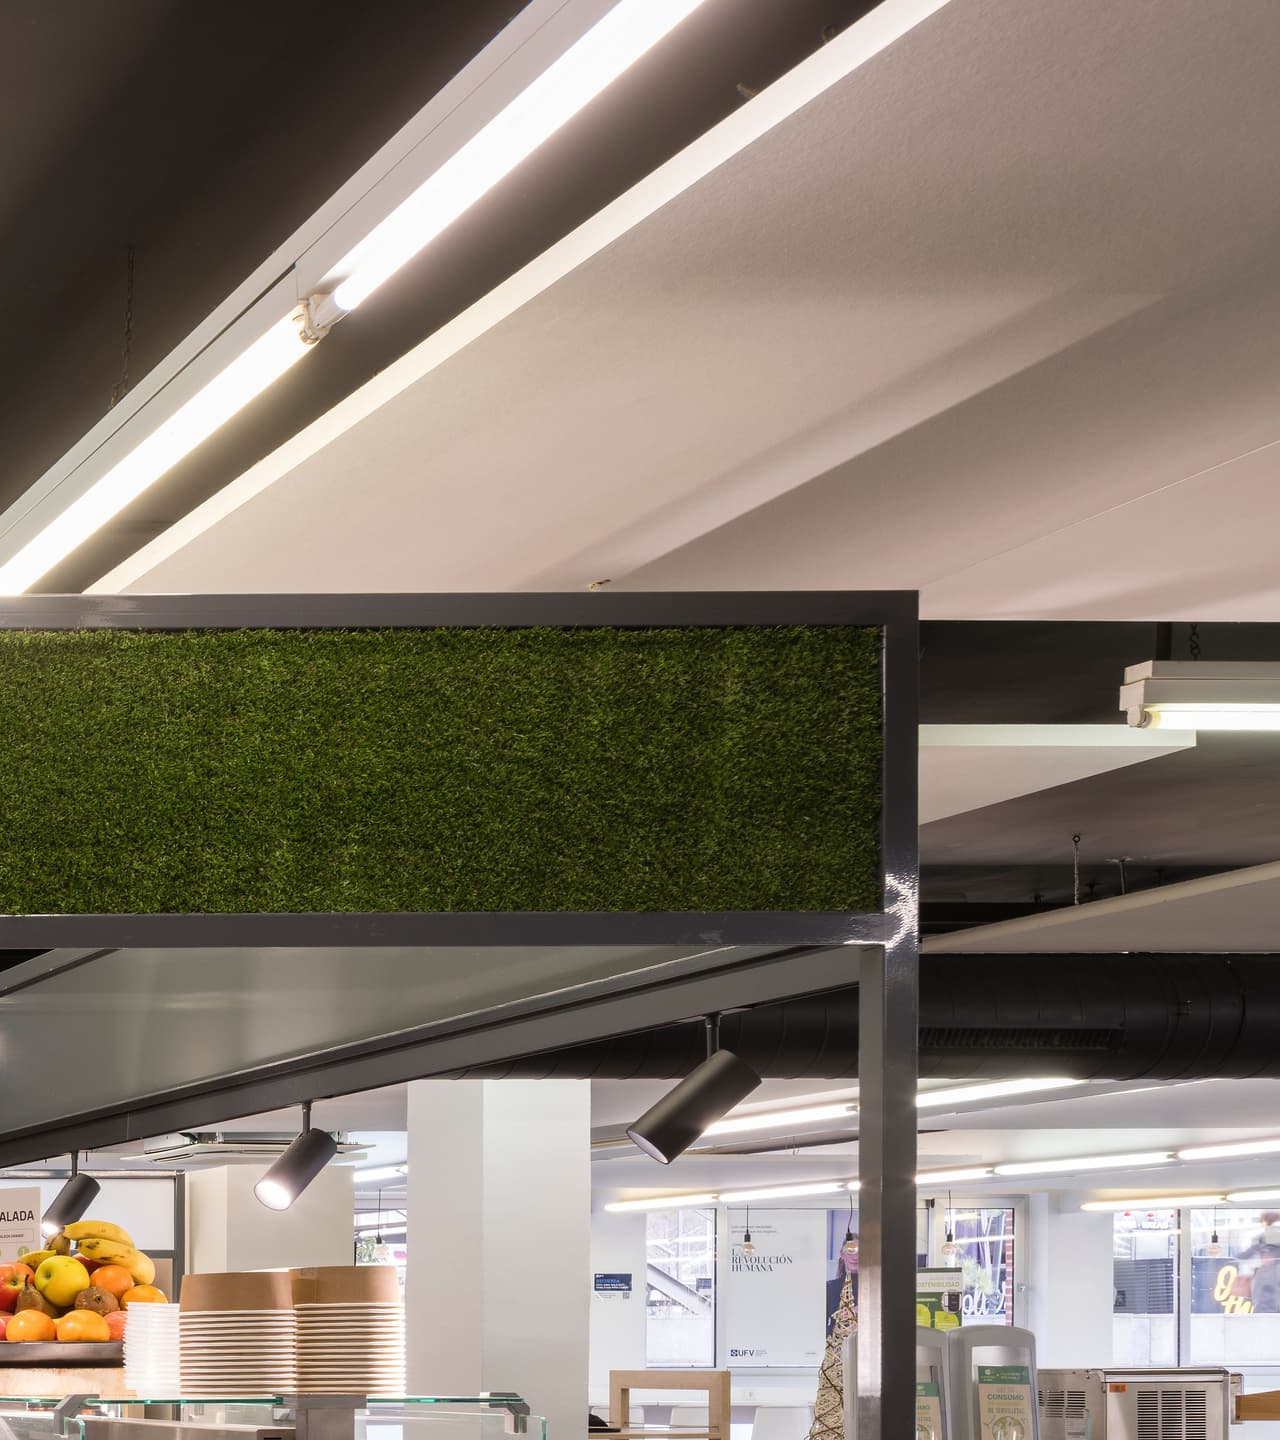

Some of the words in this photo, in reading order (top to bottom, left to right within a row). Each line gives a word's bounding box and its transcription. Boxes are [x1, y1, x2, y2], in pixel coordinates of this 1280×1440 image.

[731, 1253, 793, 1264] REVOLUCIÓN
[731, 1264, 774, 1272] HUMANA
[916, 1280, 960, 1289] OSTENIBILIDAD
[738, 1349, 755, 1357] UFV
[986, 1393, 1024, 1401] CONSUMO
